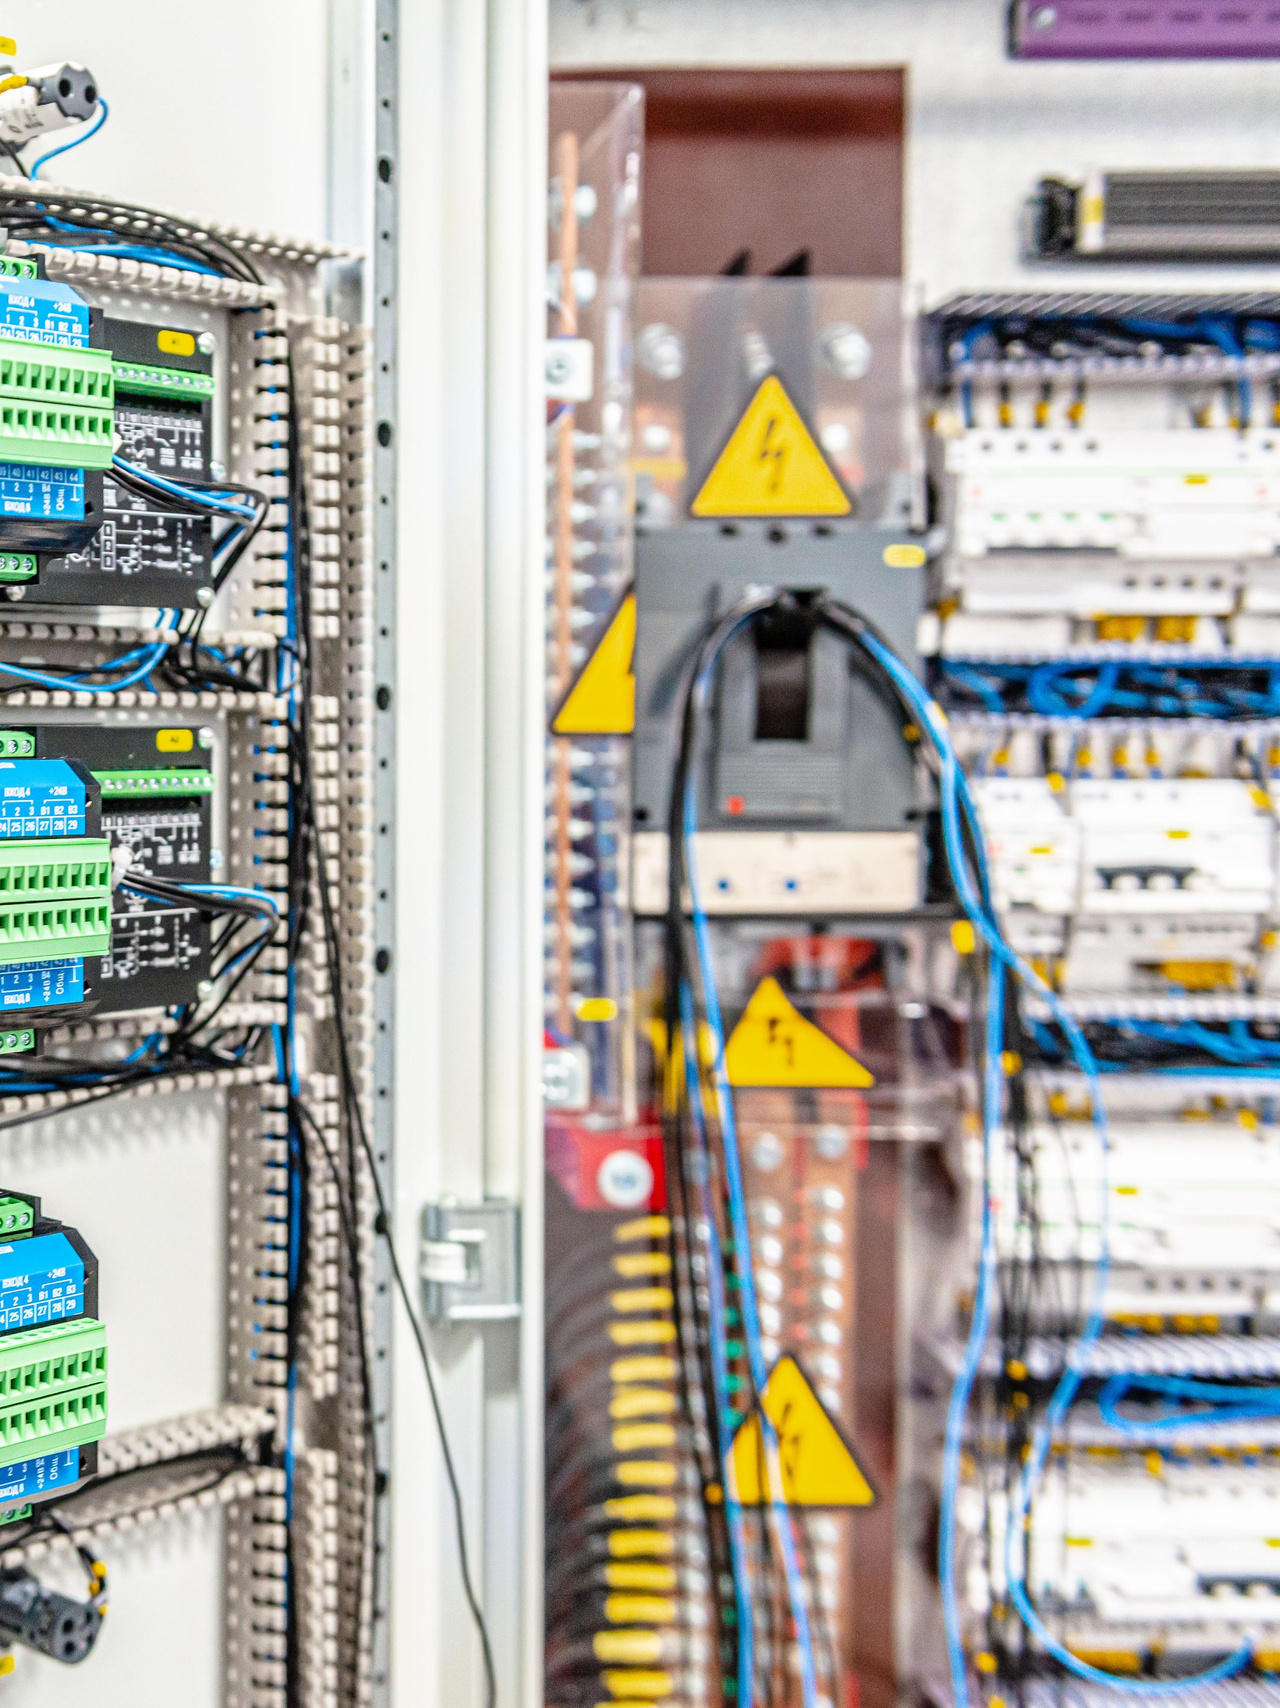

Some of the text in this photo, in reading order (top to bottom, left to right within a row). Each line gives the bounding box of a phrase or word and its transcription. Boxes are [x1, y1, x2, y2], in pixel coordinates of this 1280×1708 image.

[8, 294, 29, 307] ВХОД
[4, 502, 25, 513] ВХОД
[4, 787, 25, 798] ВХОД
[11, 822, 21, 832] 25
[26, 822, 35, 831] 26
[40, 821, 49, 830] 27
[54, 821, 64, 830] 28
[68, 820, 78, 830] 29
[4, 994, 25, 1004] ВХОД
[2, 1276, 23, 1288] ВХОД
[52, 1303, 62, 1313] 28
[66, 1300, 76, 1310] 29
[24, 1309, 33, 1319] 26
[38, 1306, 47, 1316] 27
[9, 1312, 19, 1322] 25
